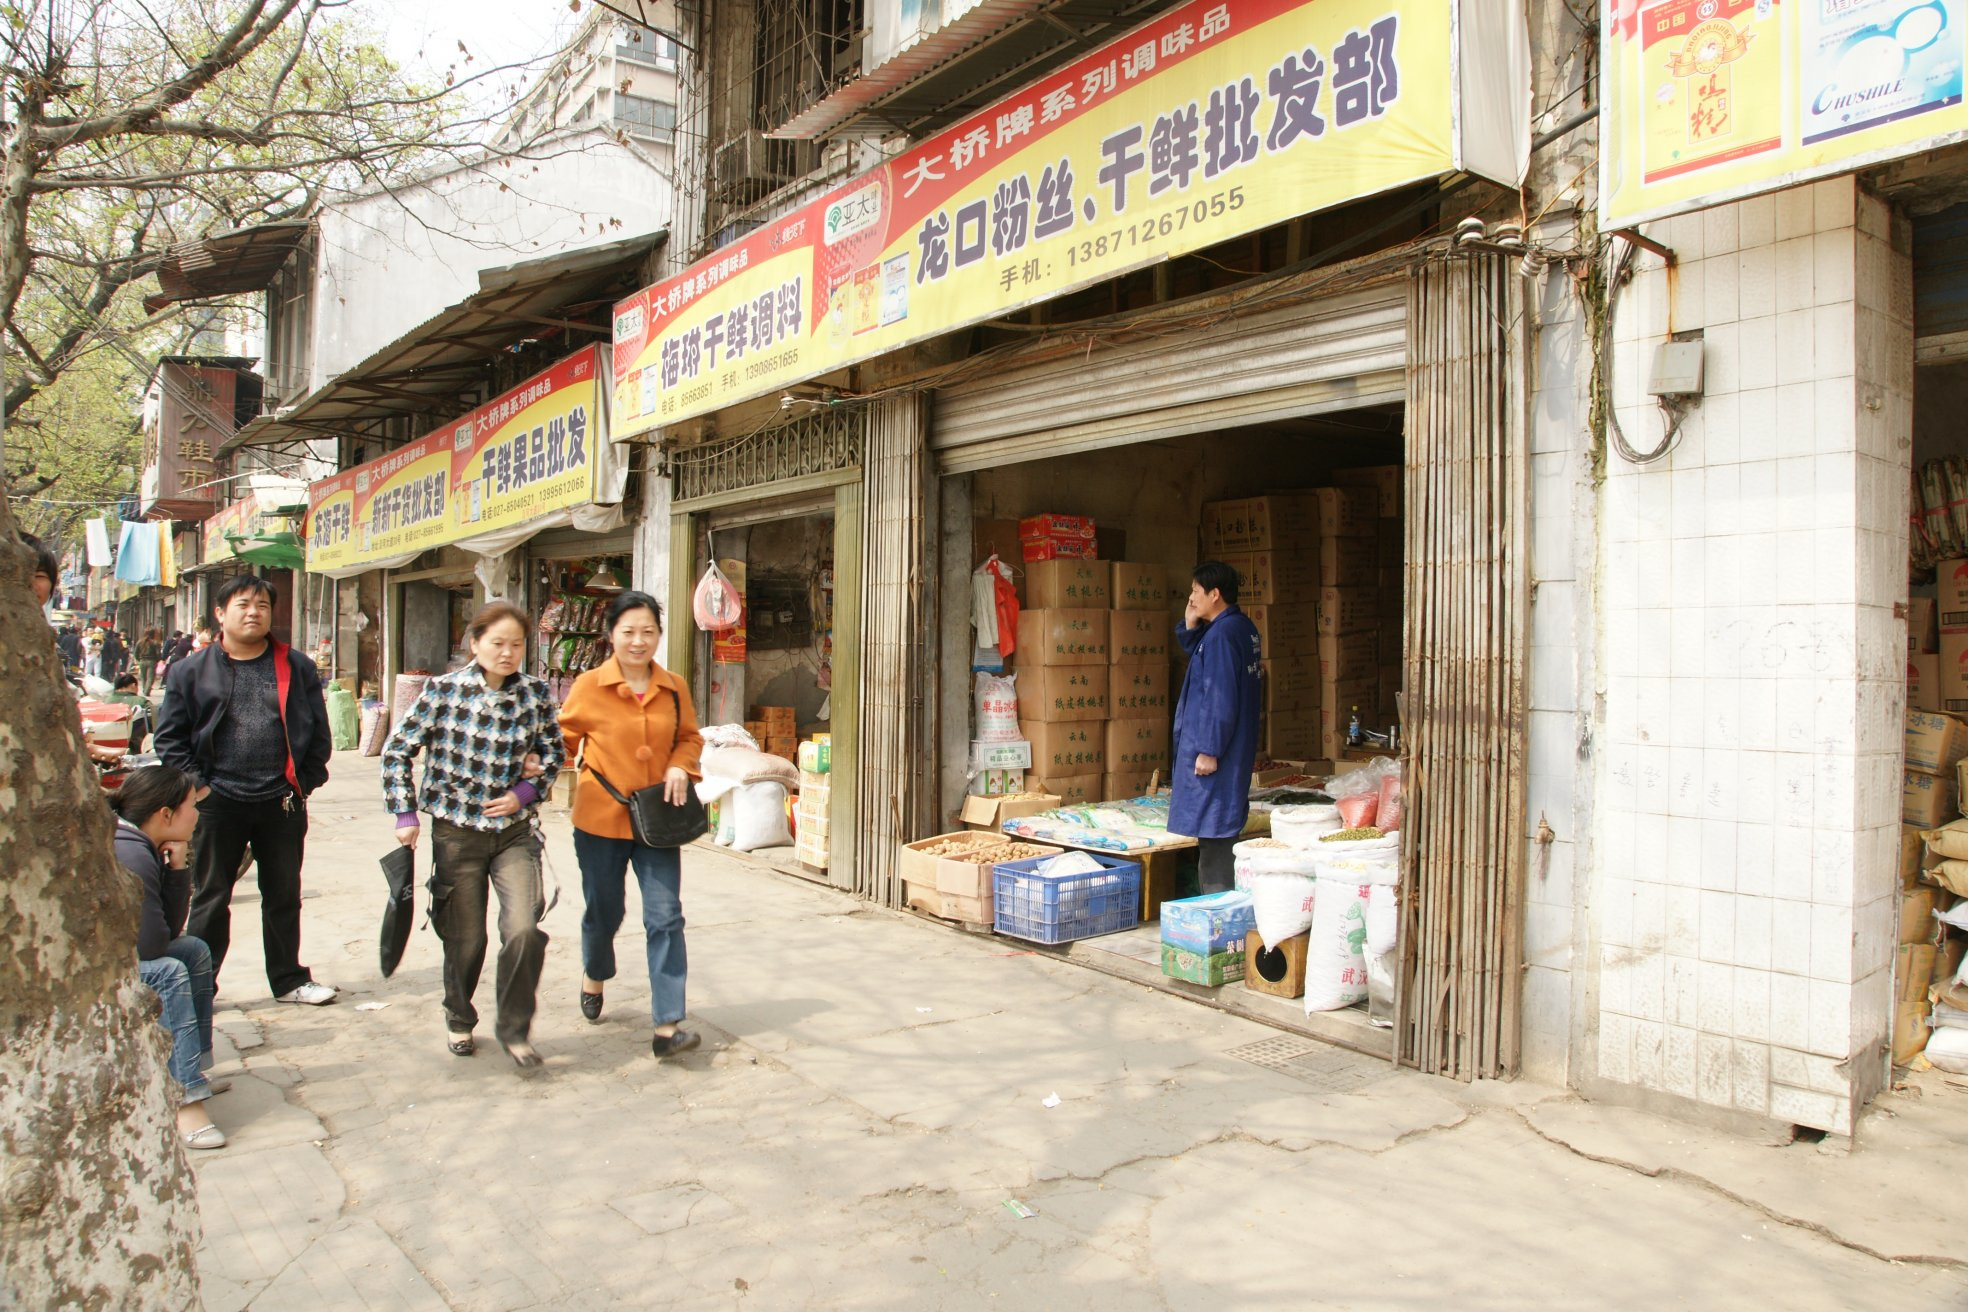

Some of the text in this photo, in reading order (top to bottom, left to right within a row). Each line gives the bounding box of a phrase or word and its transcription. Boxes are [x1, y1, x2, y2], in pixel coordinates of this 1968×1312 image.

[1657, 12, 1686, 33] 中国
[902, 3, 1231, 199] 大桥牌系列调味品
[1811, 78, 1905, 116] CHUSHILE
[917, 16, 1399, 286] 龙口粉丝、干鲜批发部
[652, 247, 749, 323] 大桥牌系列调味品
[476, 378, 552, 436] 大桥牌系列调味品
[482, 406, 587, 499] 干鲜果品批发
